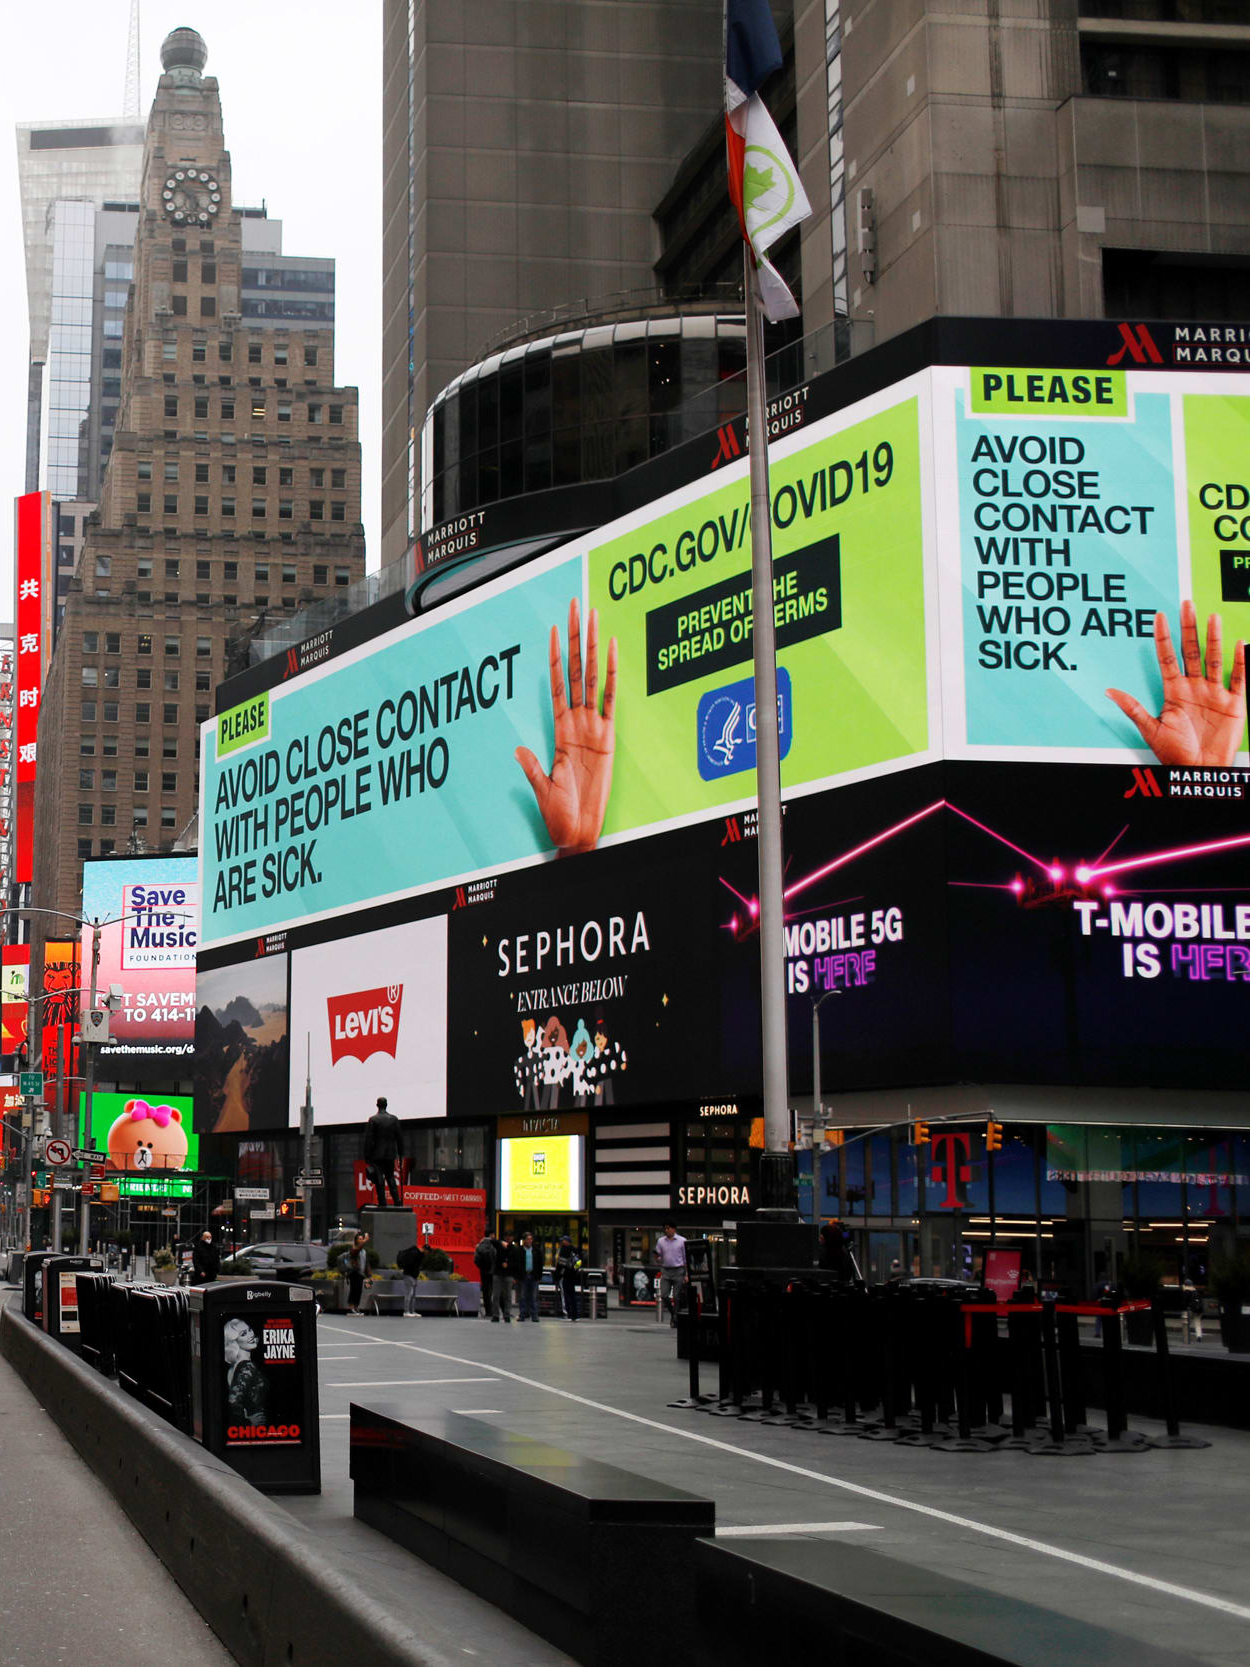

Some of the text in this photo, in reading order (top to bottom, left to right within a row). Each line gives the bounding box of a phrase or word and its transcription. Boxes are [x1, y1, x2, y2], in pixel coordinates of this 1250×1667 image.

[1175, 328, 1250, 342] MARRI
[983, 374, 1113, 404] PLEASE
[971, 435, 1085, 465] AVOID
[973, 468, 1100, 500] CLOSE
[428, 511, 486, 547] MARRIOTT
[609, 441, 894, 601] CDC.GOV/OVID19
[974, 503, 1155, 535] CONTACT
[428, 532, 478, 563] MARQUIS
[974, 536, 1071, 567] WITH
[978, 571, 1126, 602] PEOPLE
[677, 571, 799, 638] PREVENT HE
[658, 587, 829, 672] SPREAD OF ERMS
[977, 605, 1156, 638] WHO ARE
[300, 630, 333, 653] MARRIOTT
[300, 645, 330, 666] MARQUIS
[978, 641, 1077, 671] SICK.
[19, 578, 39, 764] 共克时艰
[215, 644, 521, 814] AVOID CLOSE CONTACT
[221, 700, 265, 744] PLEASE
[1170, 770, 1250, 783] MARRIOTT
[1170, 785, 1243, 798] MARQUIS
[215, 737, 450, 862] WITH PEOPLE WHO
[213, 839, 322, 913] ARE SICK.
[468, 878, 498, 894] MARRIOTT
[131, 886, 185, 906] Save
[468, 890, 494, 904] MARQUIS
[131, 907, 175, 927] The
[1073, 901, 1250, 941] T-MOBILE
[130, 924, 197, 949] Music
[266, 932, 287, 945] MARRIOTT
[266, 941, 285, 953] MARQUIS
[498, 911, 650, 977] SEPHORA
[784, 907, 903, 958] MOBILE 5G
[130, 954, 197, 962] FOUNDATION
[787, 950, 876, 994] IS HERE
[1123, 943, 1161, 979] IS
[136, 992, 196, 1007] SAVEM
[517, 975, 628, 1012] ENTRANCE BELOW
[123, 1008, 147, 1022] TO
[100, 1044, 195, 1055] savethemusic.org/d
[700, 1104, 738, 1117] SEPHORA
[678, 1186, 749, 1204] SEPHORA
[263, 1329, 295, 1344] ERIKA
[264, 1345, 295, 1359] JAYNE
[227, 1424, 301, 1439] CHICAGO
